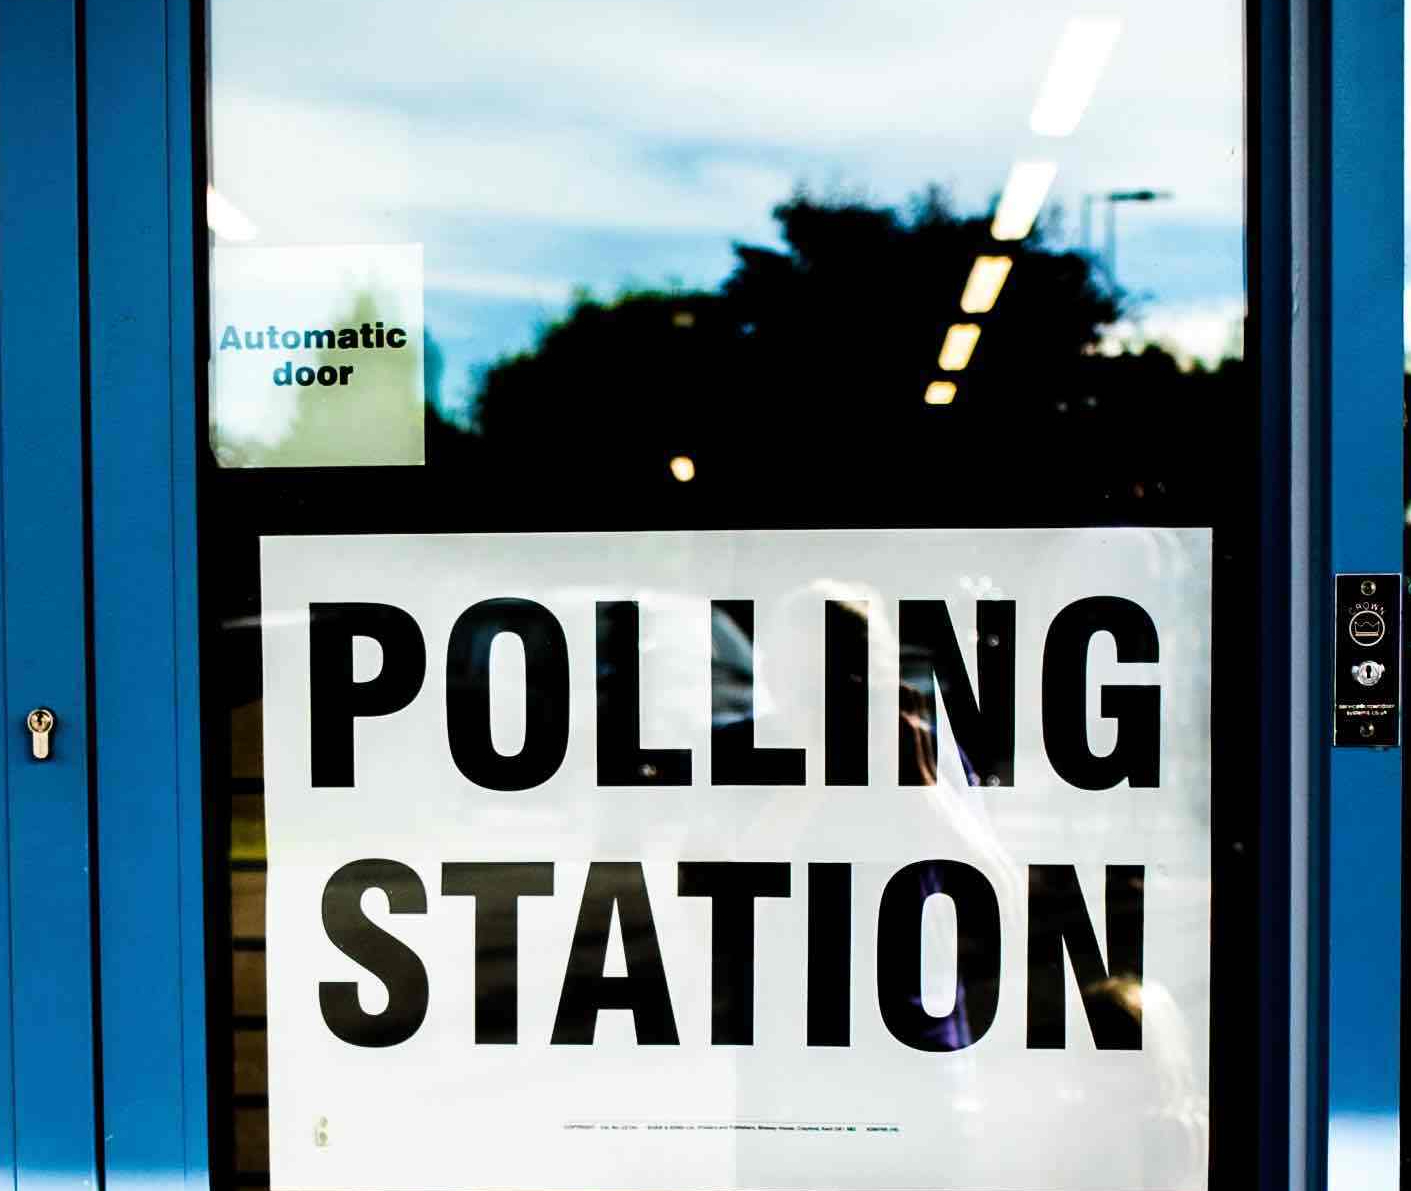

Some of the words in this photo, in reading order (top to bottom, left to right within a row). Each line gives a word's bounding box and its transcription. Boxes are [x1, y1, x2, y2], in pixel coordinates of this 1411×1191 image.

[220, 322, 407, 350] Automatic
[273, 361, 354, 386] door
[308, 595, 1161, 791] POLLING
[318, 858, 1145, 1052] STATION
